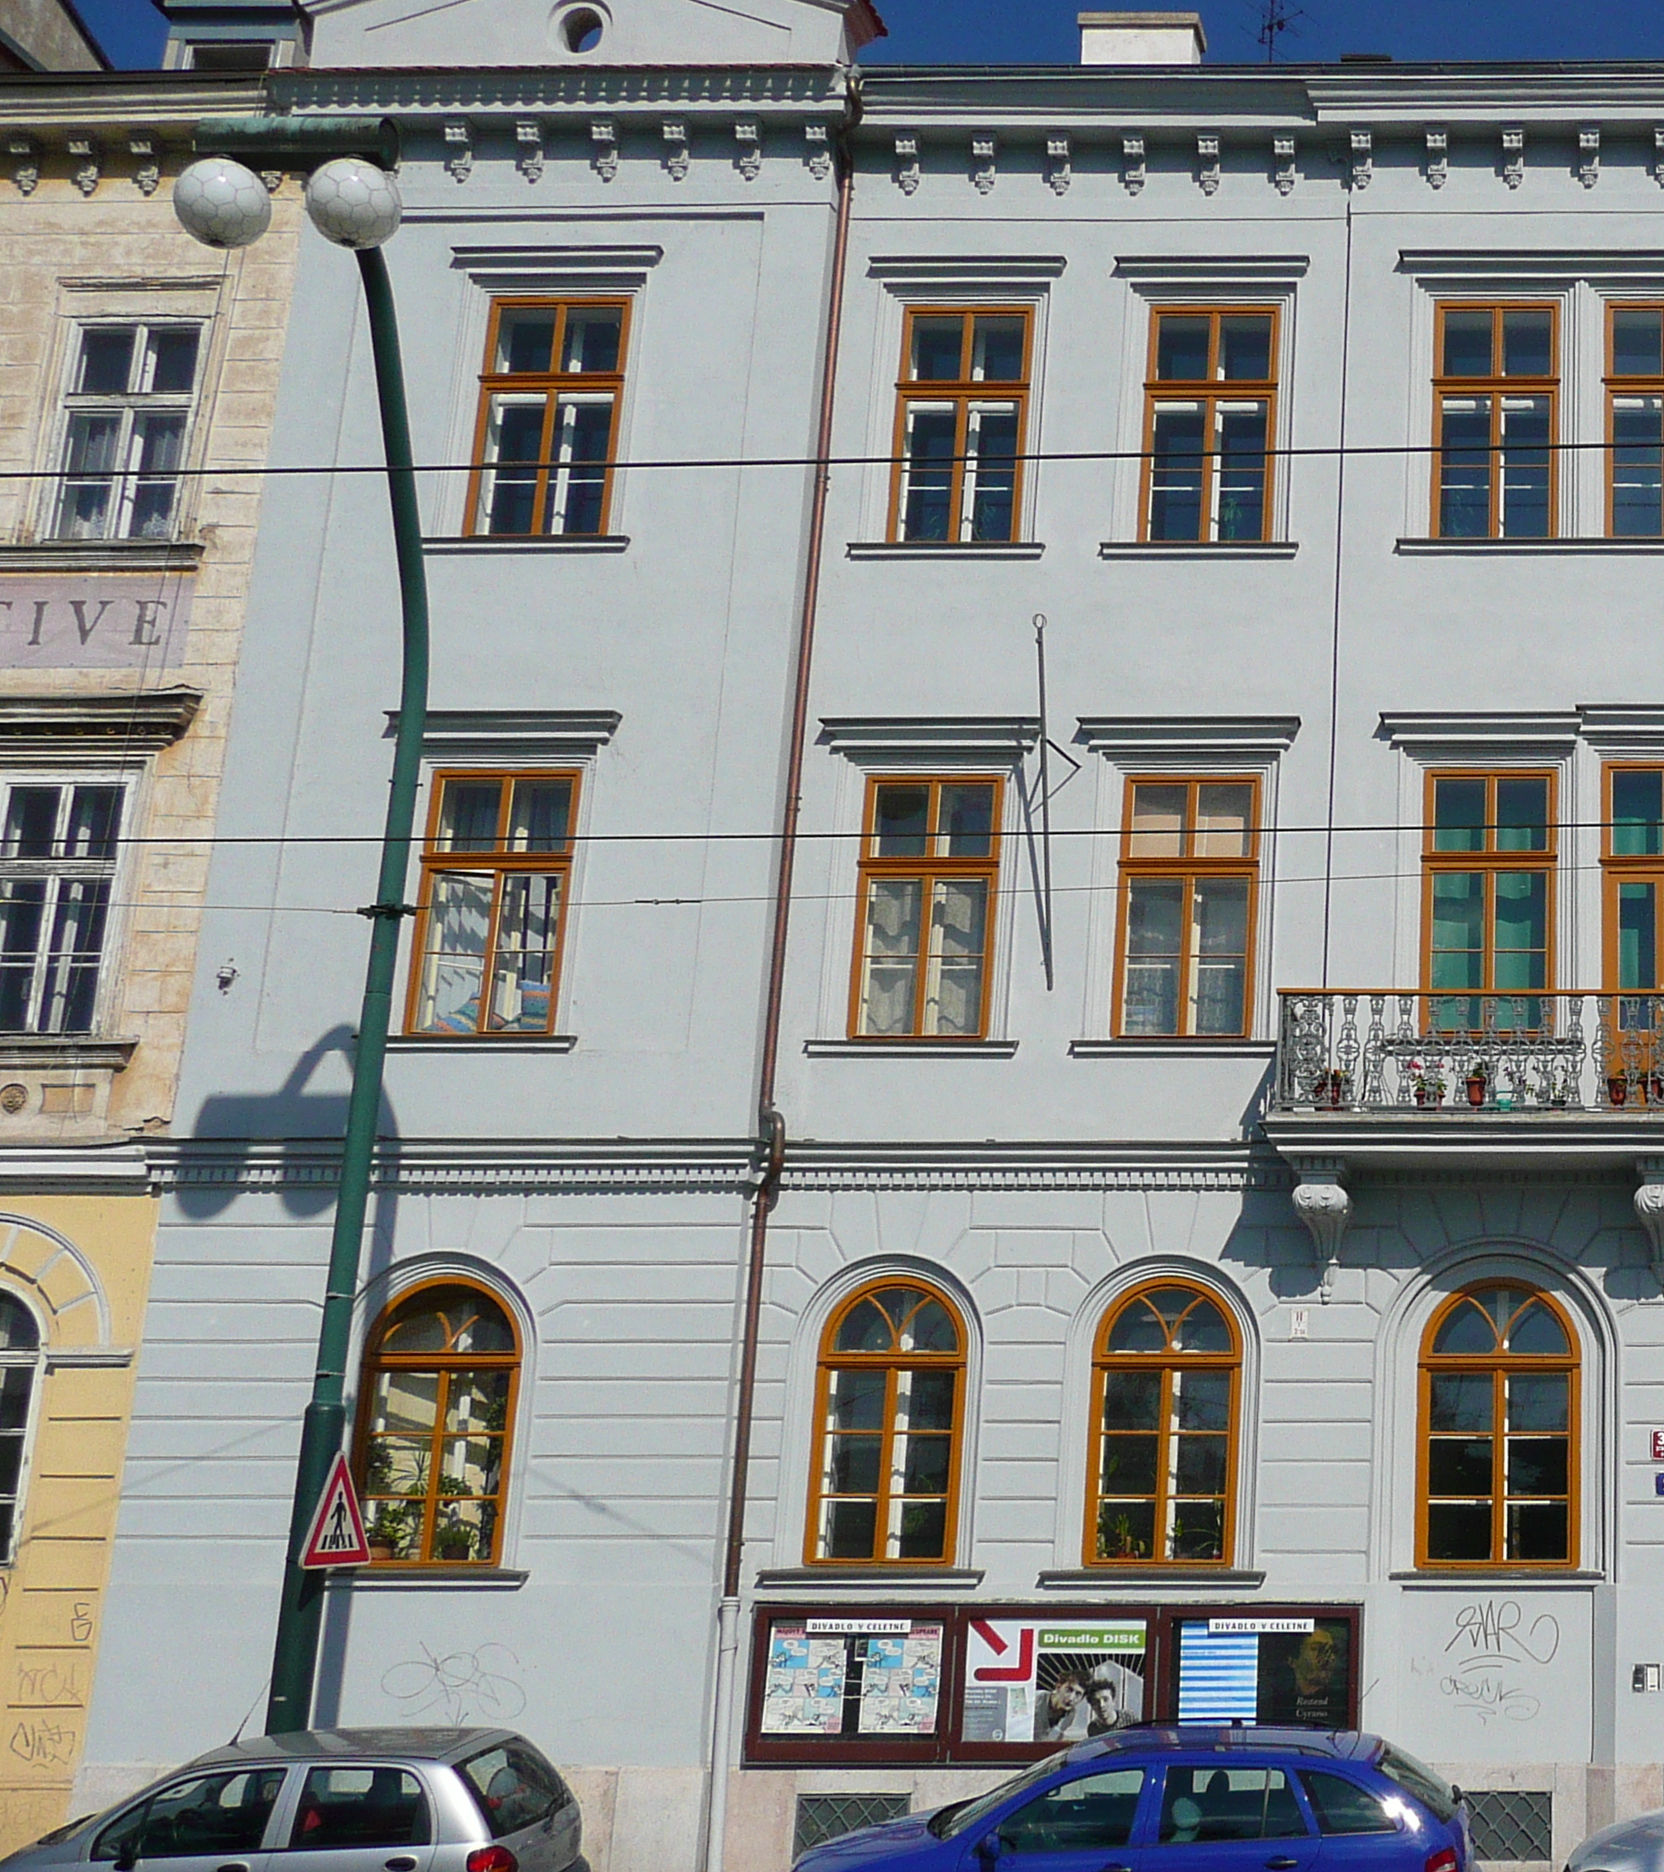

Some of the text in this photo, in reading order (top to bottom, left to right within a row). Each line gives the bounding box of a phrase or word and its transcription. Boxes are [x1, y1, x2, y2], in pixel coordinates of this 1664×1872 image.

[811, 1622, 853, 1631] DIVADLO
[1214, 1622, 1256, 1630] DIVADLO
[1043, 1633, 1140, 1644] Divadlo DISK
